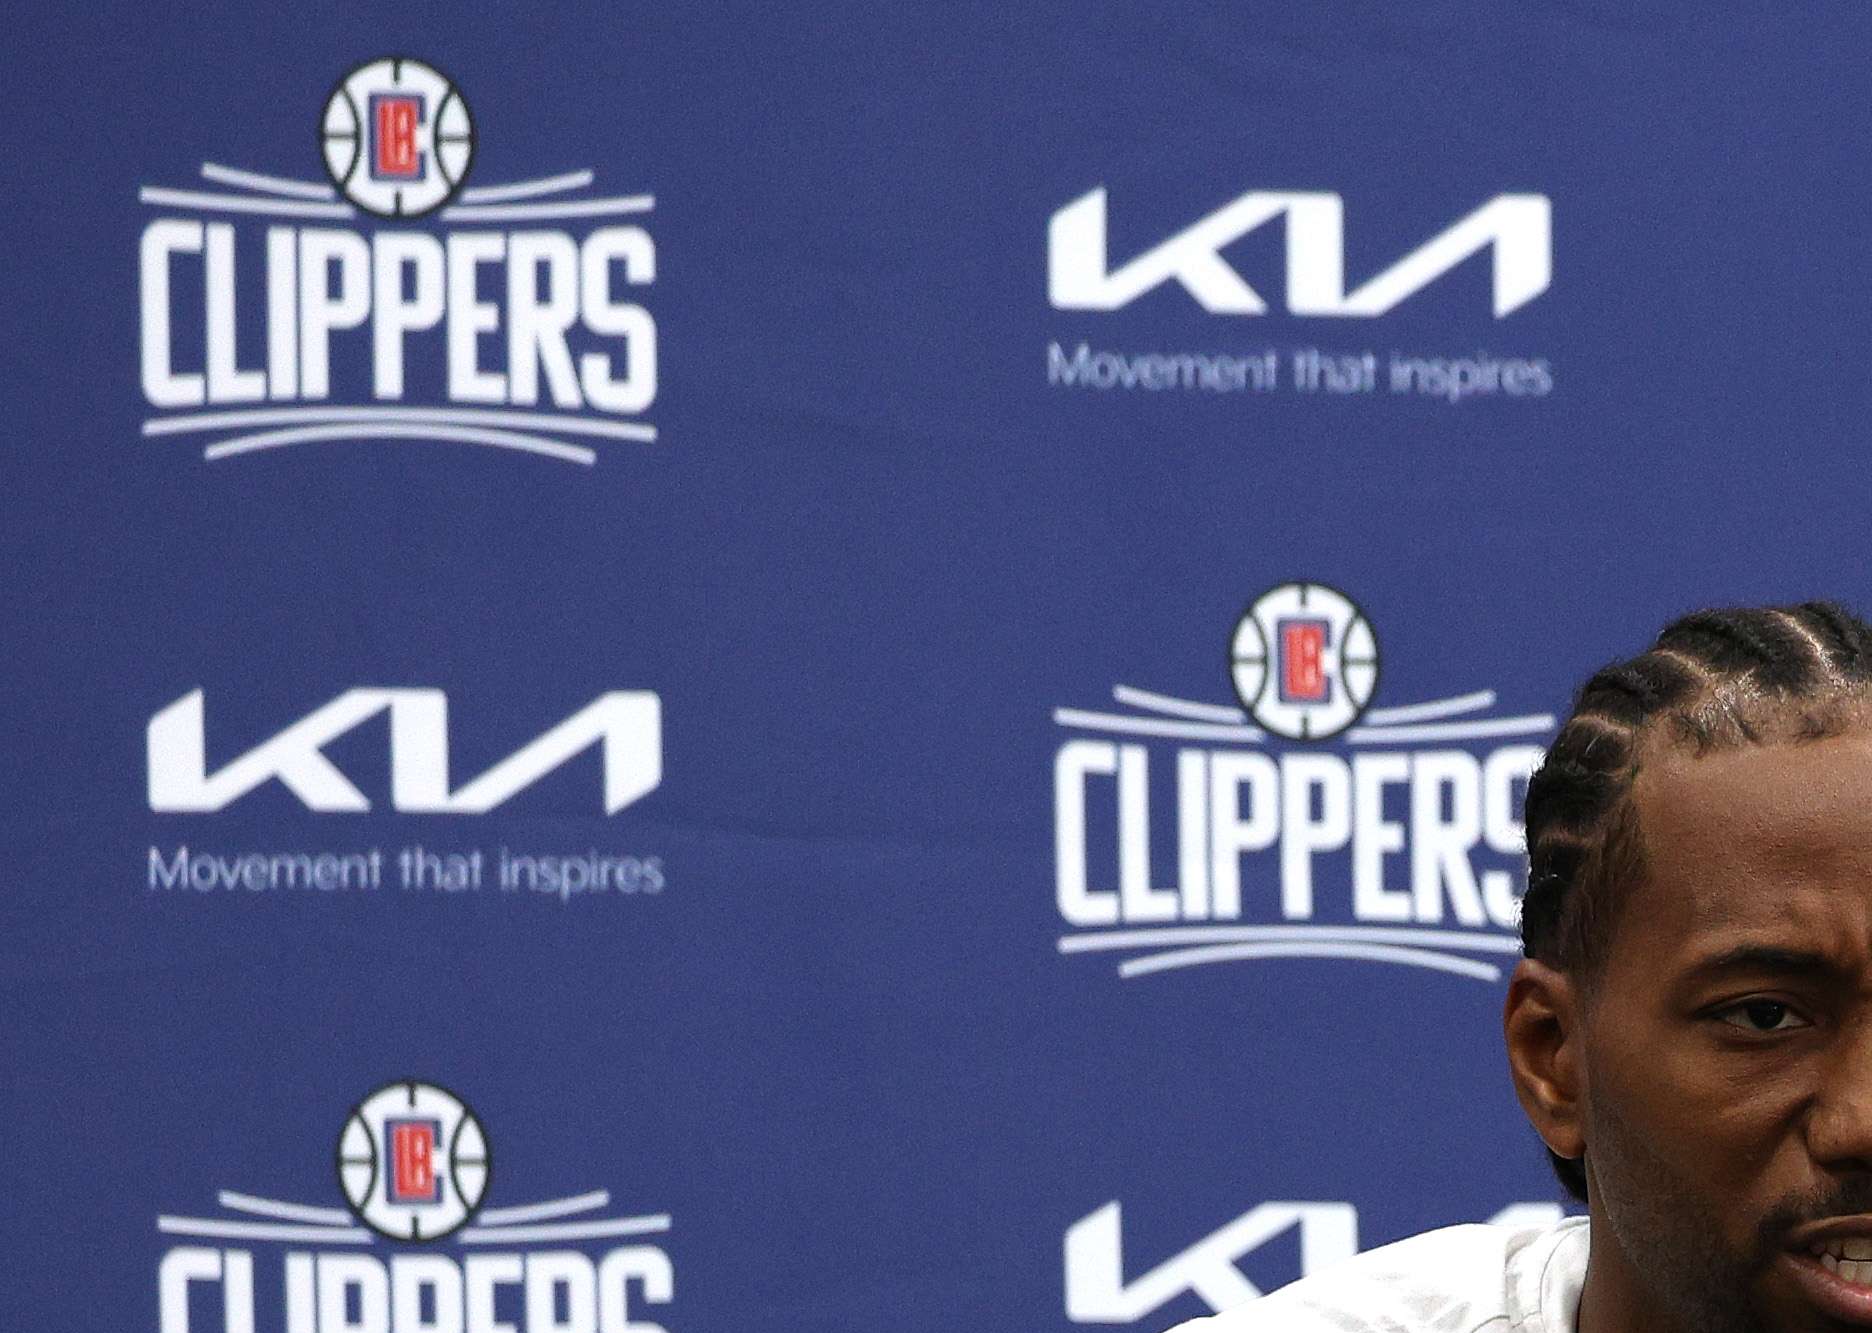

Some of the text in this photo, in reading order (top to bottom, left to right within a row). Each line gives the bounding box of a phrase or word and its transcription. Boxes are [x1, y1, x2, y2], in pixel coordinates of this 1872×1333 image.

[141, 220, 656, 413] CLIPPERS
[1048, 188, 1552, 318] KIA
[1047, 341, 1553, 403] Movement that inspires
[147, 688, 662, 815] KIA
[148, 845, 665, 902] Movement that inspires
